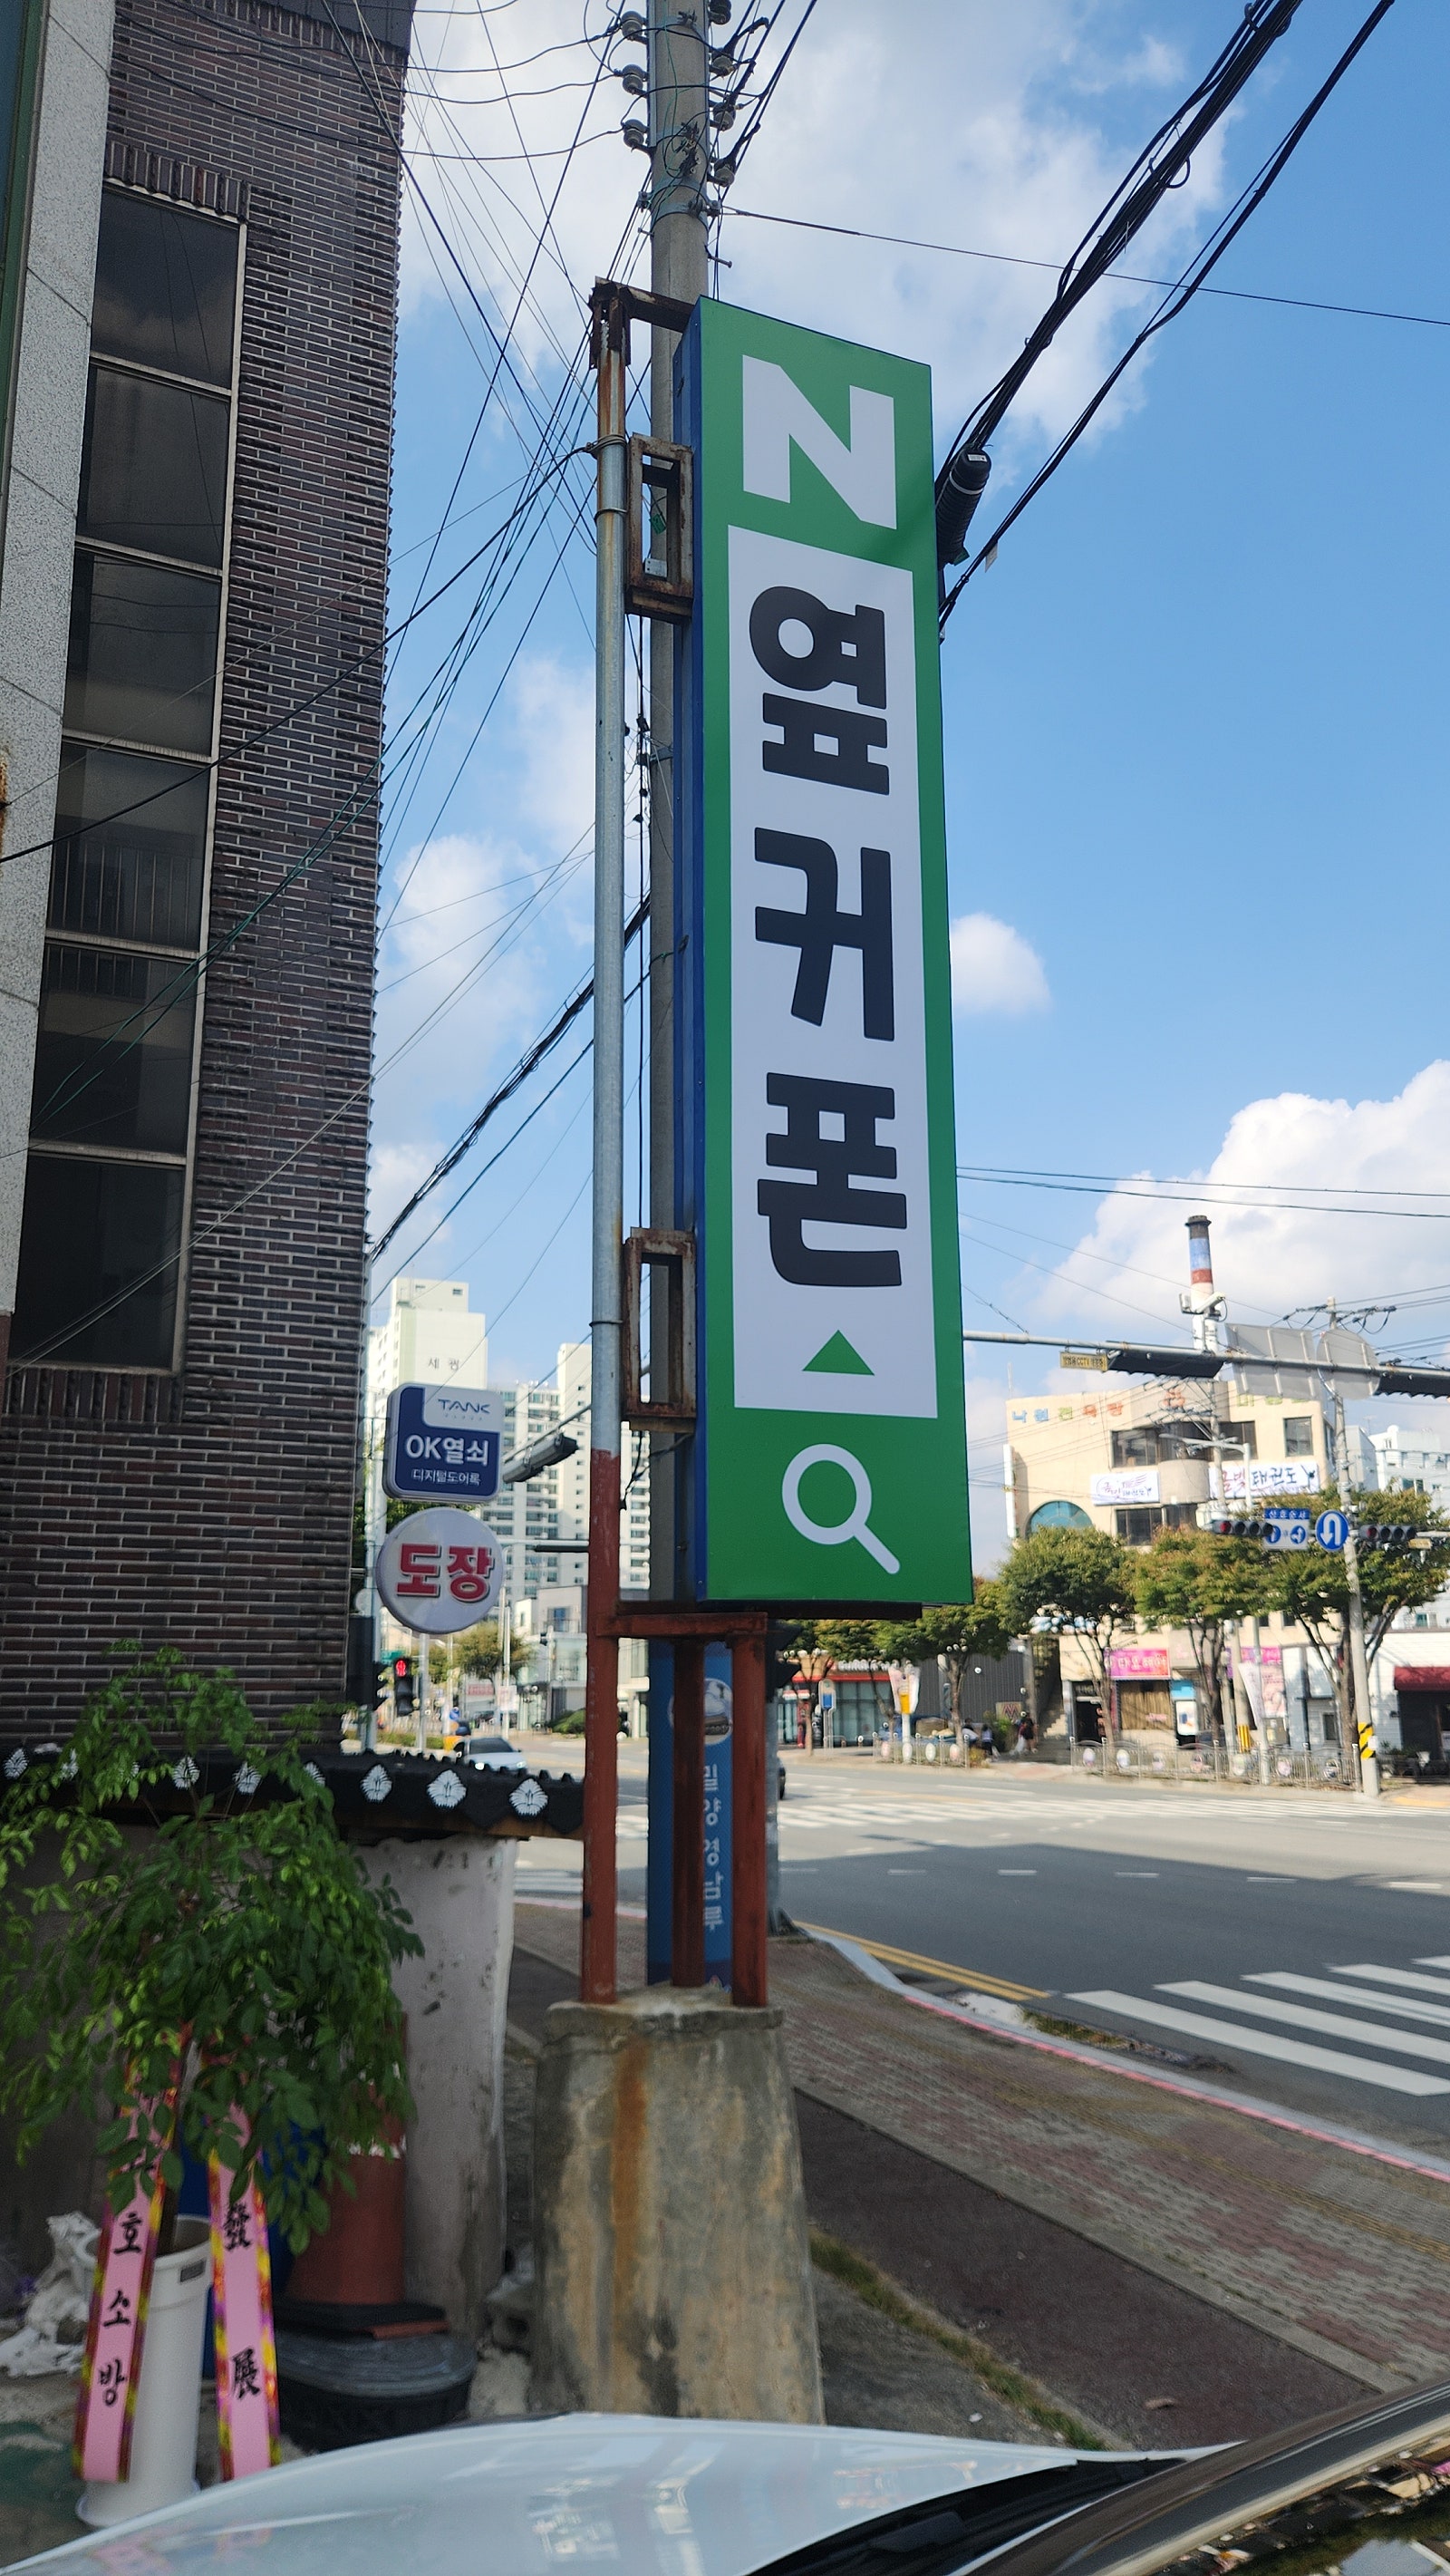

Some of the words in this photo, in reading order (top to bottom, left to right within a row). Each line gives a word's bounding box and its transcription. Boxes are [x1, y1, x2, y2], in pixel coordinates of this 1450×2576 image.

[742, 354, 896, 529] N
[749, 585, 907, 1288] 옆커폰
[438, 1399, 491, 1414] TANK
[405, 1434, 489, 1467] OK열쇠
[1251, 1467, 1298, 1487] 태권도
[396, 1543, 495, 1603] 도장
